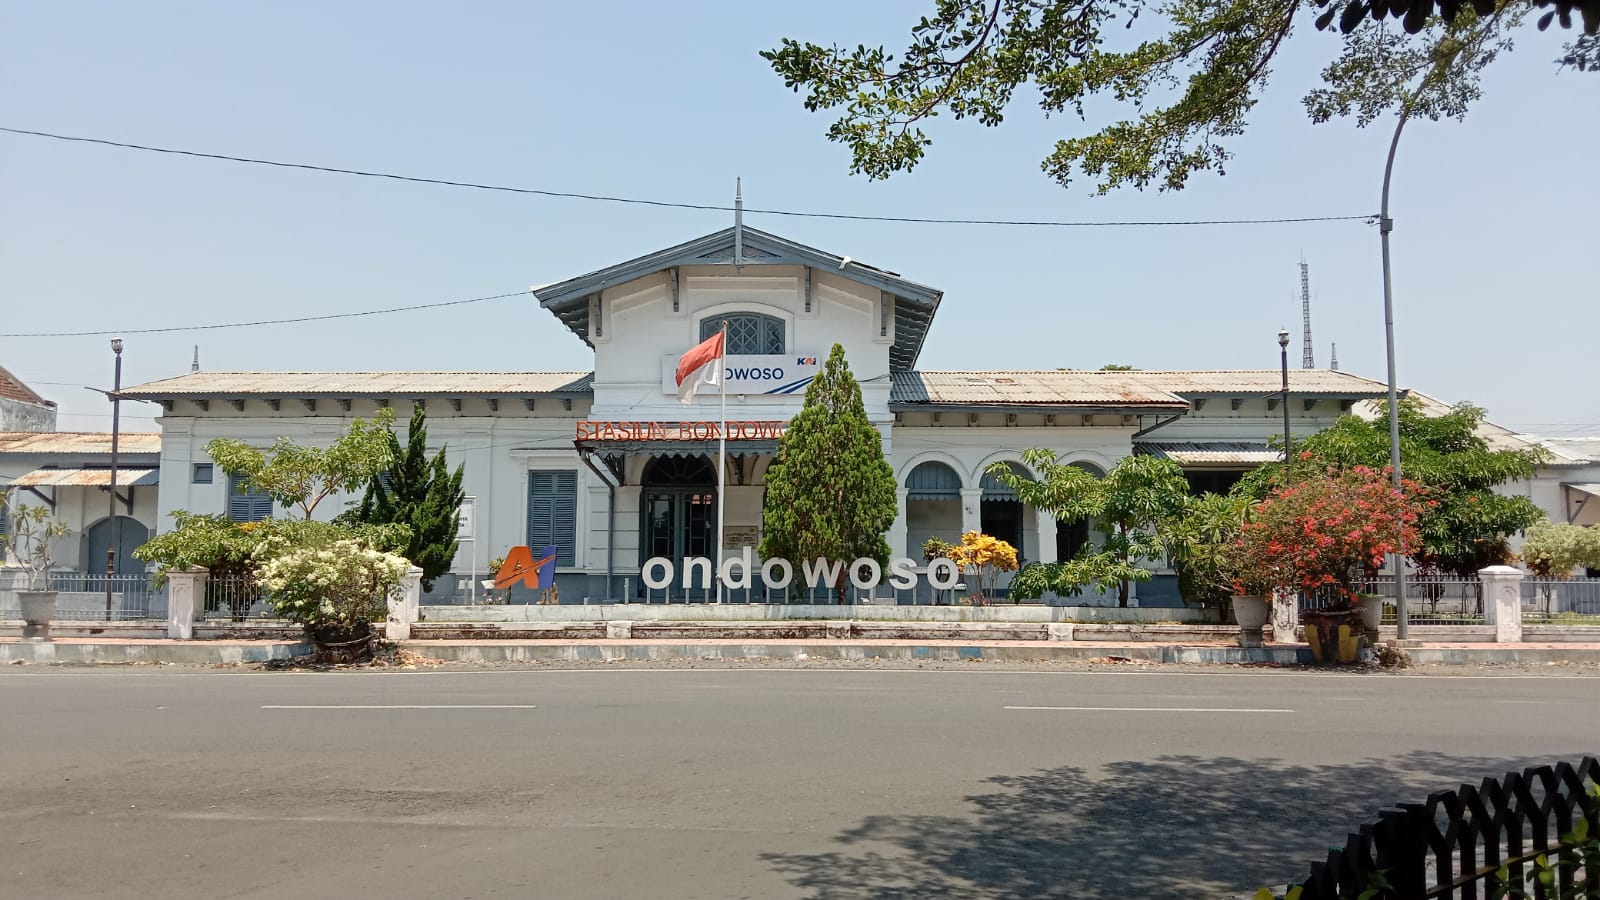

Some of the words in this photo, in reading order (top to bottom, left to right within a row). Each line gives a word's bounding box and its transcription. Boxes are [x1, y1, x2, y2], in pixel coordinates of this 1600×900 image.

[723, 367, 784, 380] OWOSO
[576, 421, 667, 442] STASIUN
[641, 546, 959, 590] ondowoso
